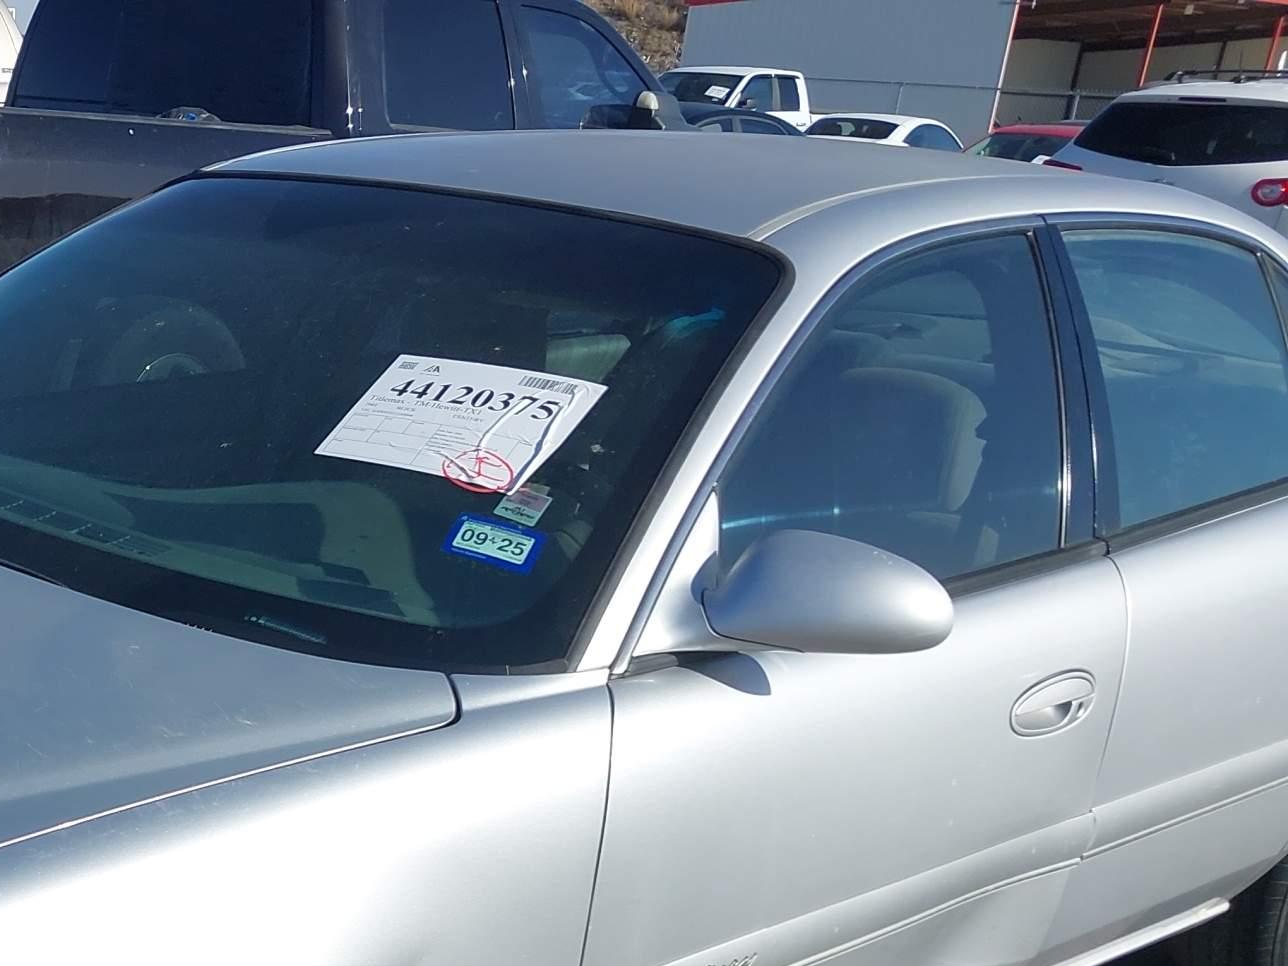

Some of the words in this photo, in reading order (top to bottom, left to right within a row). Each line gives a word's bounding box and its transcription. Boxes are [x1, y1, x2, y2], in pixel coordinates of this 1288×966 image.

[390, 378, 561, 421] 44120375
[461, 528, 488, 546] 09
[496, 538, 528, 557] 25
